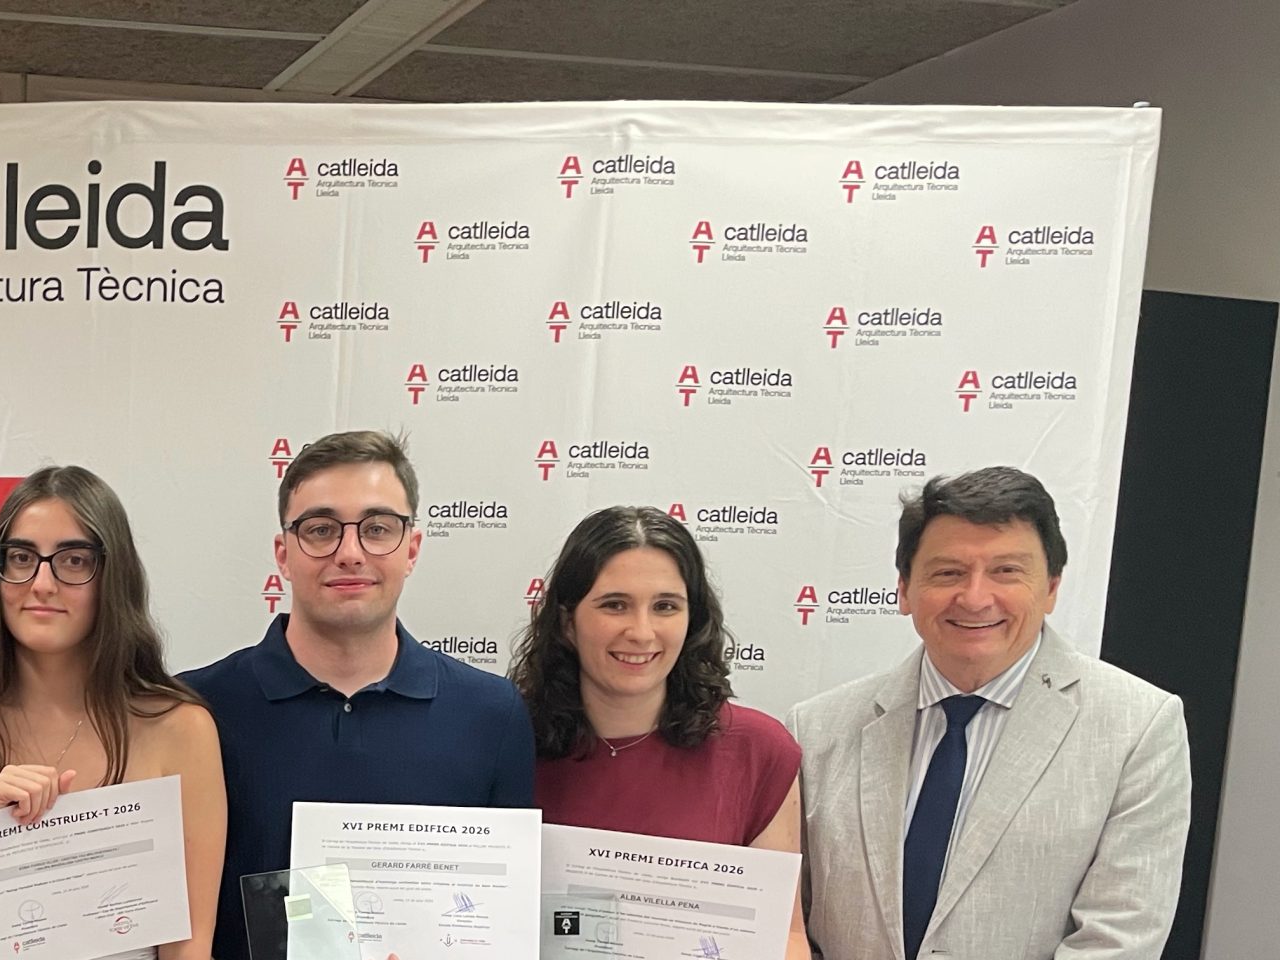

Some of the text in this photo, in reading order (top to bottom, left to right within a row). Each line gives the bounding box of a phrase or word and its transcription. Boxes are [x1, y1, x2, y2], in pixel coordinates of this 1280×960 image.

[318, 158, 399, 176] catlleida
[593, 154, 675, 174] catlleida
[875, 161, 960, 180] catlleida
[591, 177, 641, 185] Arquitectura
[873, 183, 924, 191] Arquitectura
[448, 221, 530, 239] catlleida
[724, 223, 808, 242] catlleida
[1008, 226, 1093, 244] catlleida
[447, 243, 496, 251] Arquitectura
[723, 244, 772, 252] Arquitectura
[1006, 248, 1058, 256] Arquitectura
[77, 267, 224, 304] Tècnica
[310, 302, 389, 320] catlleida
[580, 301, 662, 320] catlleida
[858, 308, 942, 326] catlleida
[856, 329, 906, 337] Arquitectura
[438, 364, 519, 382] catlleida
[710, 368, 792, 386] catlleida
[992, 371, 1076, 389] catlleida
[709, 388, 758, 396] Arquitectura
[989, 392, 1041, 400] Arquitectura
[569, 441, 649, 459] catlleida
[842, 448, 926, 466] catlleida
[428, 501, 508, 518] catlleida
[697, 506, 778, 524] catlleida
[696, 525, 744, 533] Arquitectura
[828, 587, 898, 605] catlleid
[826, 607, 876, 615] Arquitectura
[25, 808, 109, 832] CONSTRUEIX-T
[114, 802, 140, 815] 2026
[342, 822, 490, 835] XVI PREMI EDIFICA 2026
[371, 860, 459, 871] GERARD FARRÉ BENET
[588, 848, 744, 876] XVI PREMI EDIFICA 2026
[620, 893, 700, 910] ALBA VILELLA PENA
